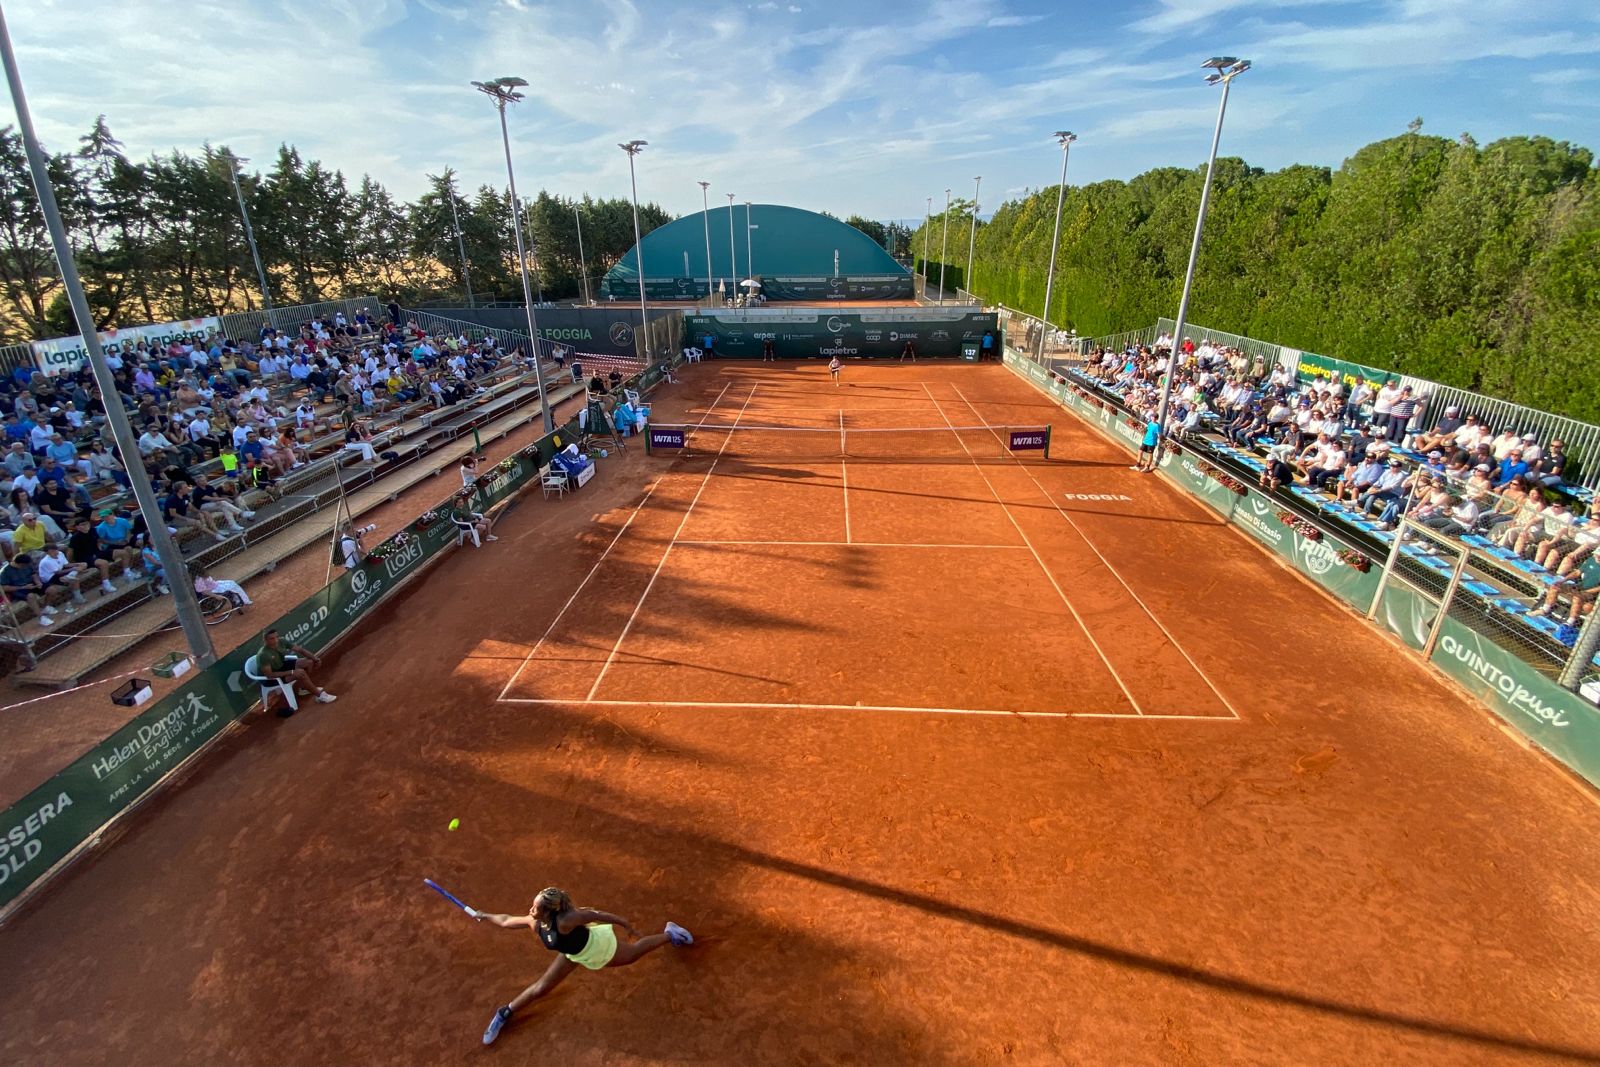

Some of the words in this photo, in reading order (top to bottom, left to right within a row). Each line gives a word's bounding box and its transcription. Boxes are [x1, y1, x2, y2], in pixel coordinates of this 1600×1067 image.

[545, 328, 593, 340] FOGGIA
[654, 434, 672, 443] WTA
[672, 434, 681, 443] 125
[1013, 436, 1032, 446] WTA
[1032, 436, 1042, 445] 125
[1064, 493, 1133, 501] FOGGIA
[1259, 521, 1282, 541] Stasio
[389, 544, 419, 572] LOVE
[344, 579, 382, 614] wave
[309, 605, 329, 628] 2D
[92, 737, 141, 780] Helen
[137, 704, 187, 745] Doron
[143, 718, 188, 760] English
[109, 783, 130, 803] APRI
[130, 773, 142, 785] LA
[143, 760, 160, 774] TUA
[163, 743, 182, 760] SEDE
[191, 713, 219, 738] FOGGIA
